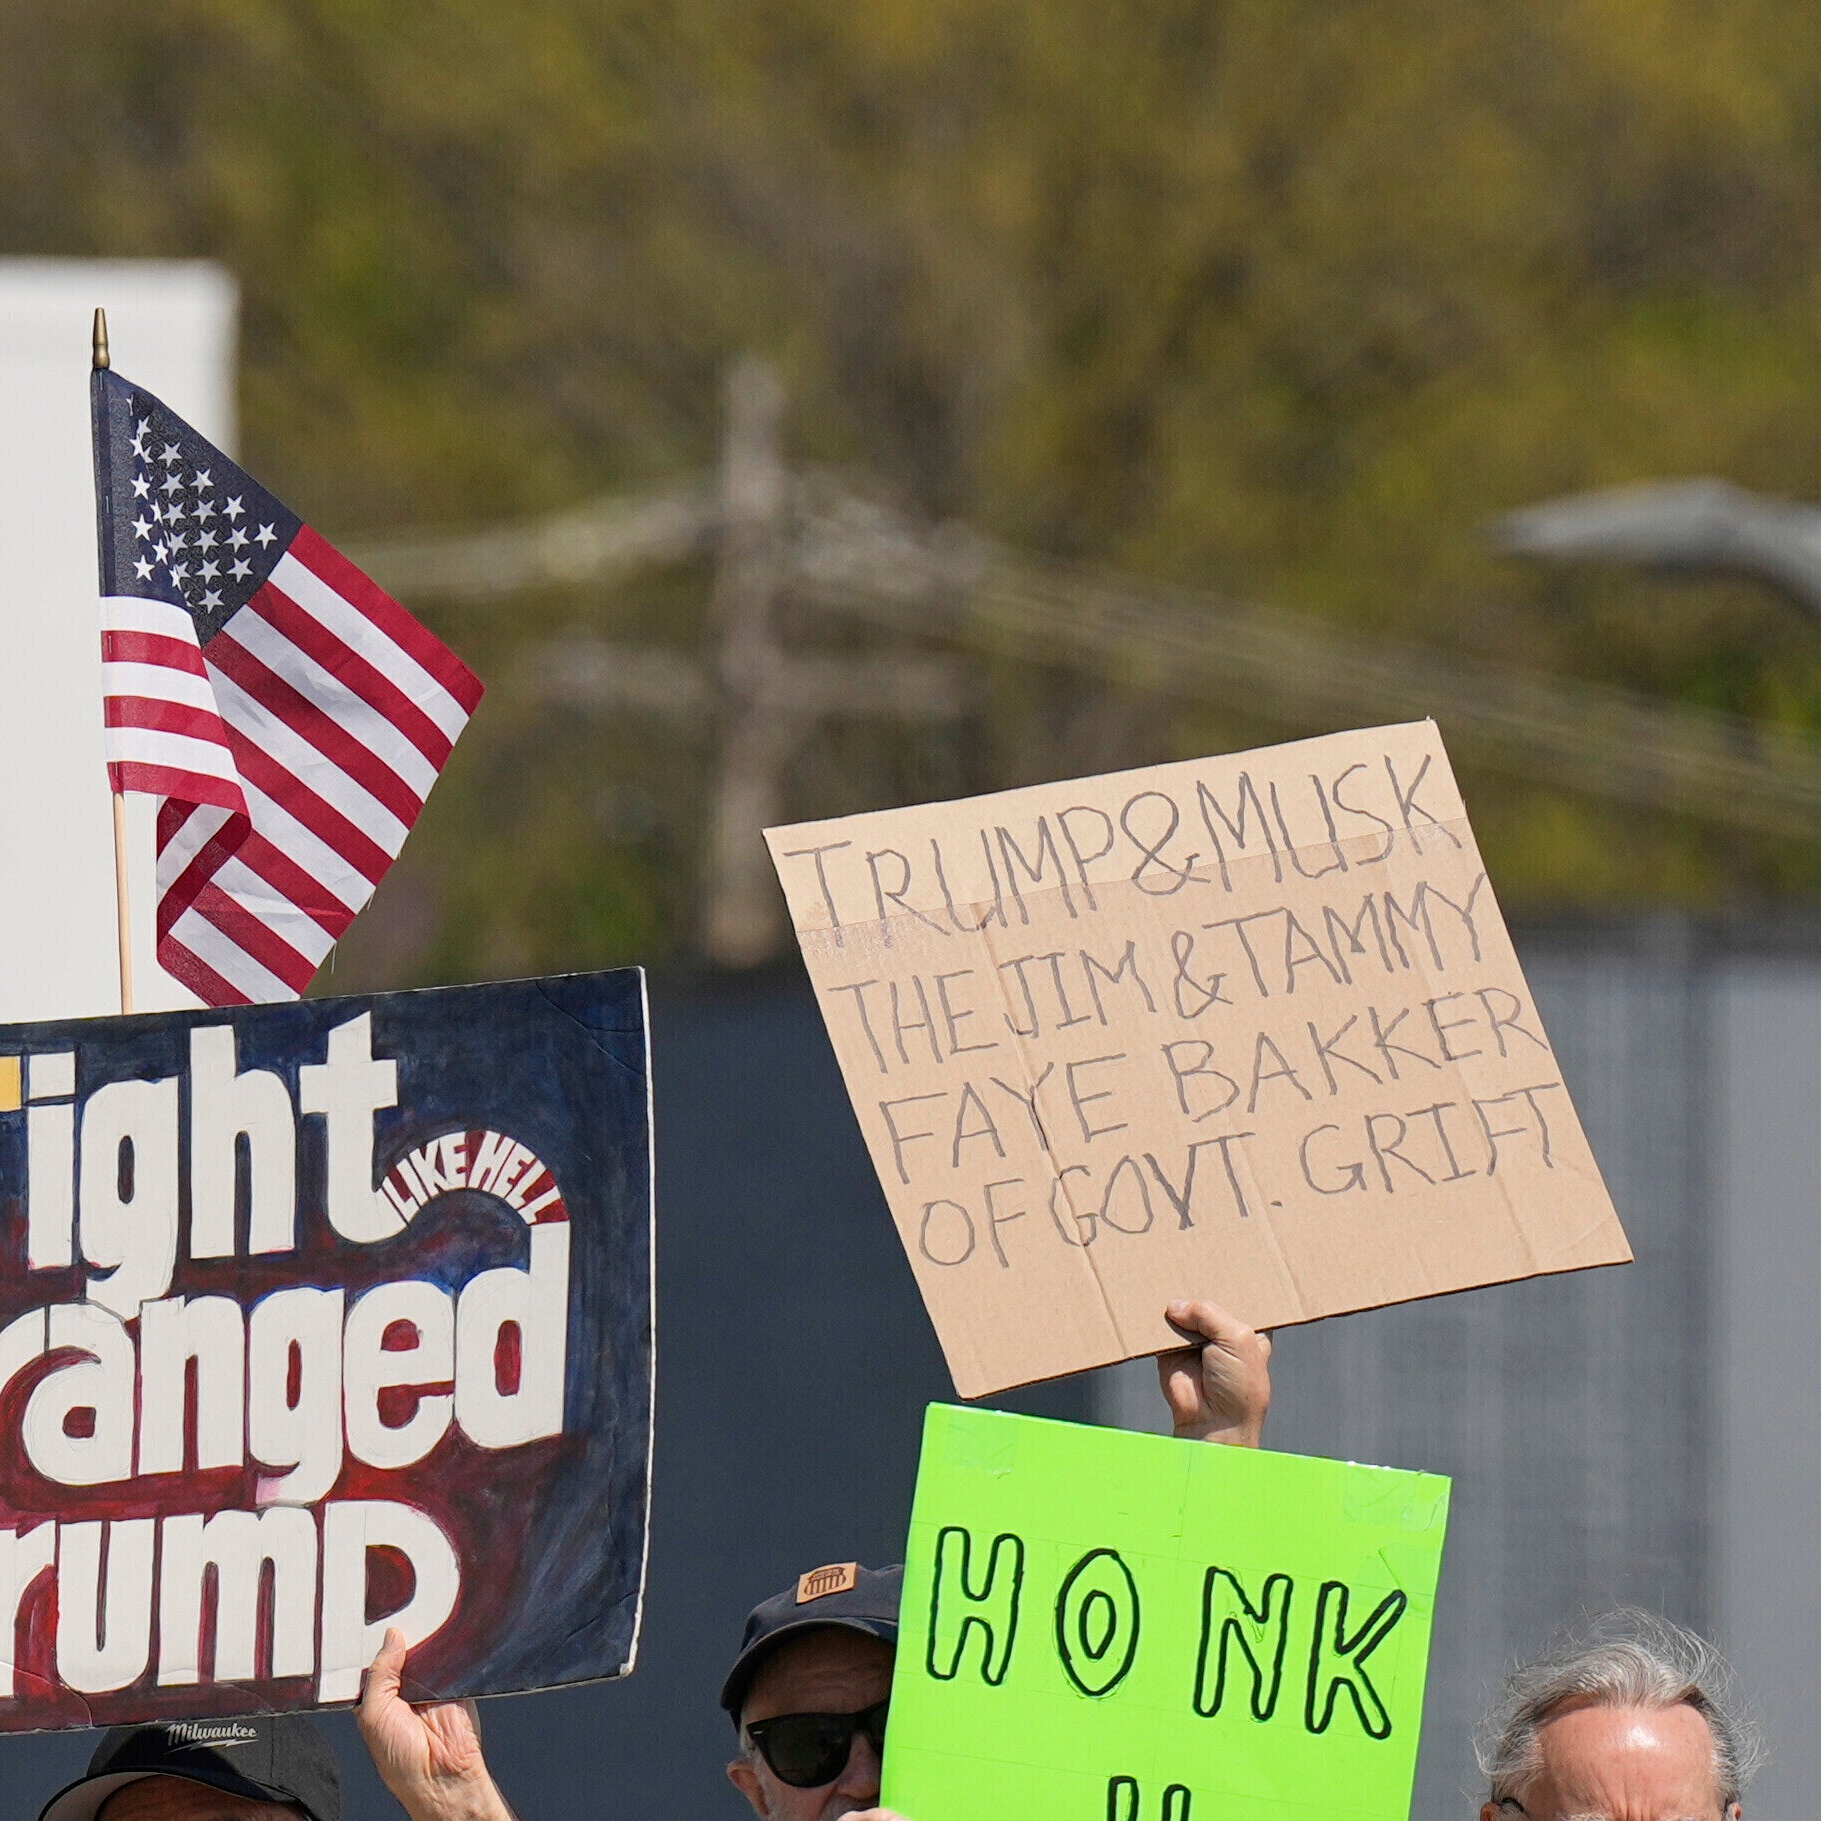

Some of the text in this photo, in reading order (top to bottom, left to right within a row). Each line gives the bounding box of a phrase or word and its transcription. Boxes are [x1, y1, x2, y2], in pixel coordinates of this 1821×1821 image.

[827, 970, 1000, 1074] THE
[878, 987, 1549, 1185] FAYE BAKKER
[381, 1129, 562, 1226] LIKE HELL
[918, 1177, 1027, 1269] OF
[1299, 1083, 1561, 1195] GRIFT
[925, 1525, 1408, 1741] HONK
[165, 1722, 258, 1747] Milwaukee
